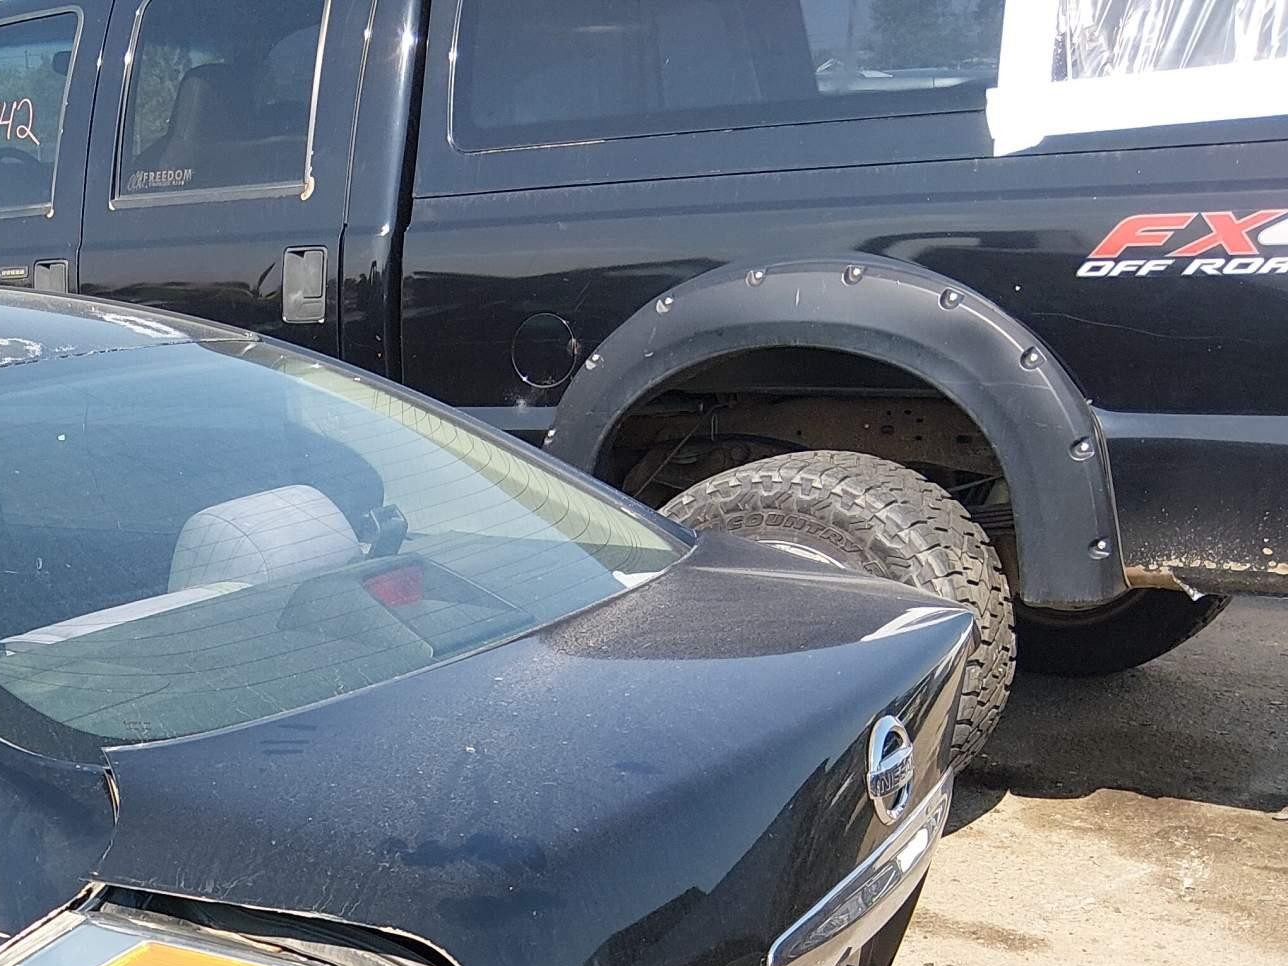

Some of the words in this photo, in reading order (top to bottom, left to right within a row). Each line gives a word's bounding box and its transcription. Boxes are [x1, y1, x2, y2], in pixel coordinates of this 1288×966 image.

[143, 168, 192, 183] FREEDOM
[1076, 257, 1177, 277] OFF
[726, 512, 864, 553] COUNTRY
